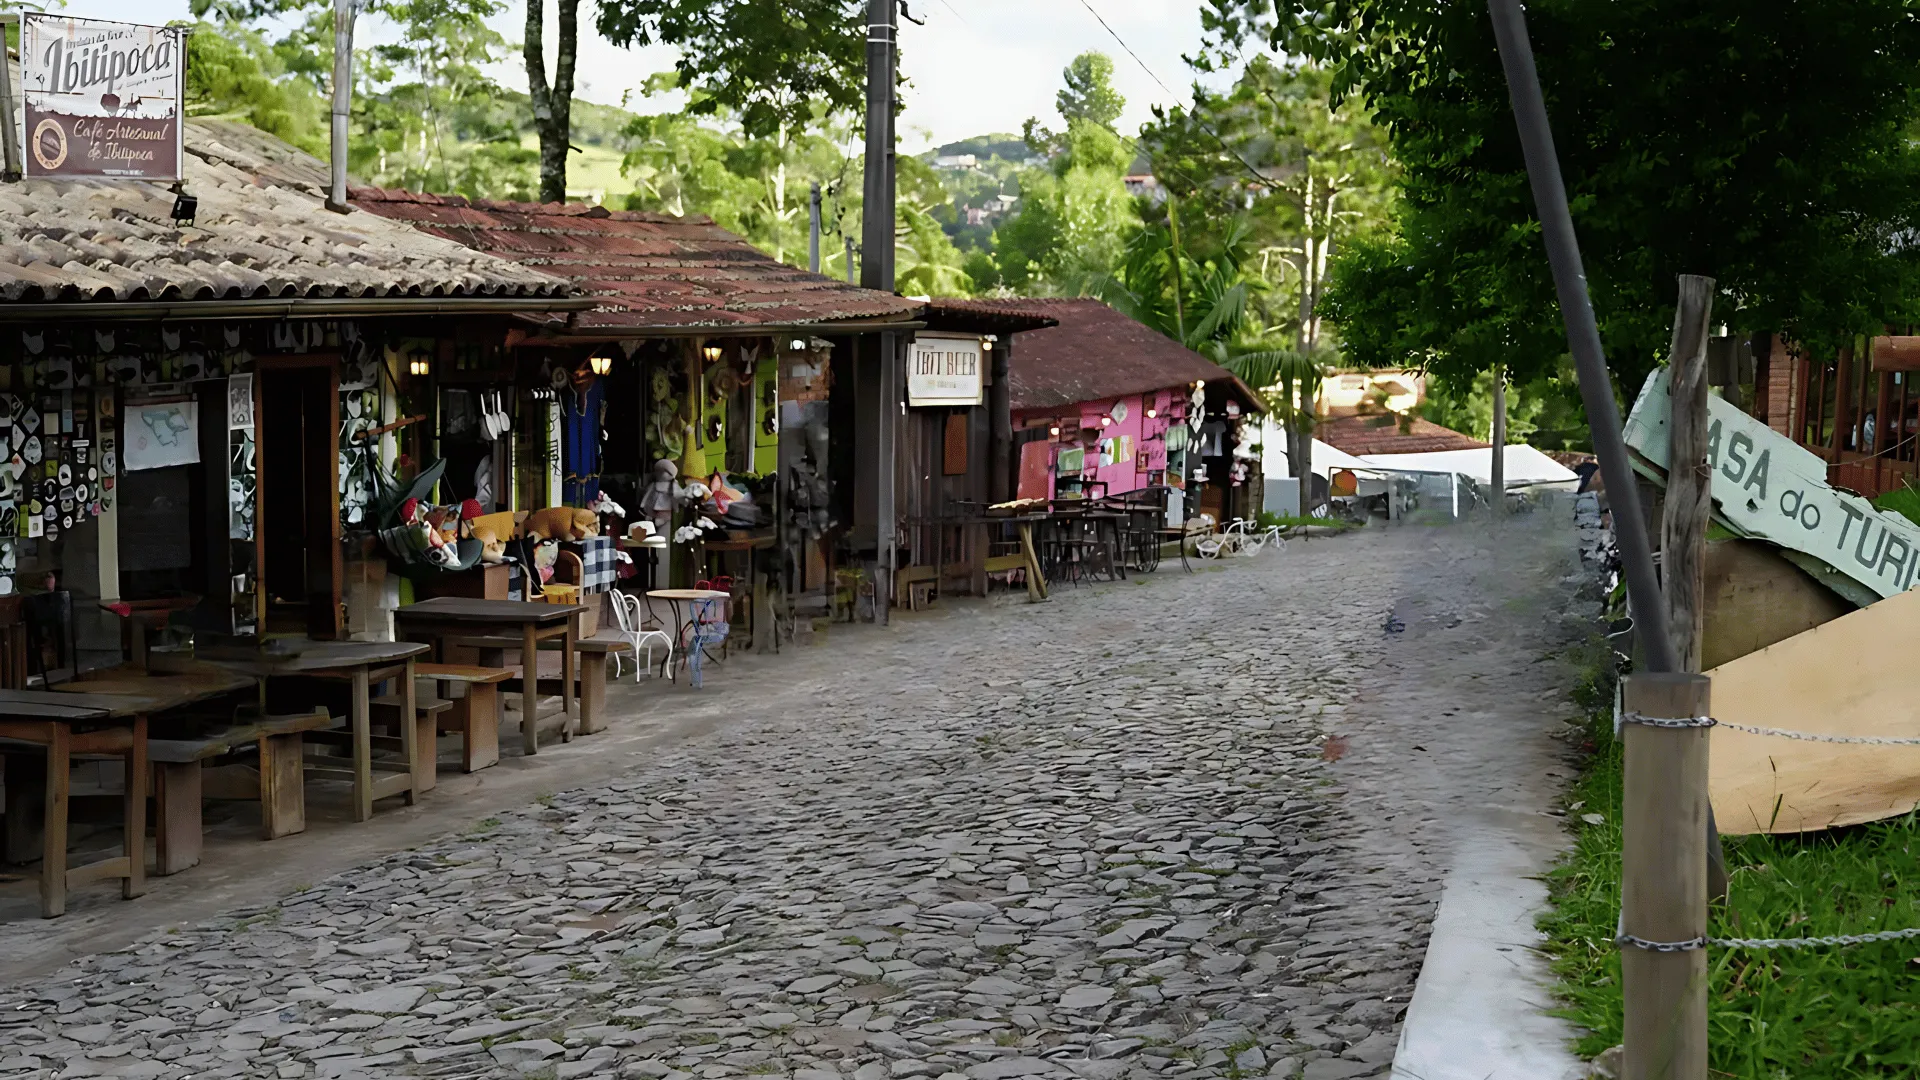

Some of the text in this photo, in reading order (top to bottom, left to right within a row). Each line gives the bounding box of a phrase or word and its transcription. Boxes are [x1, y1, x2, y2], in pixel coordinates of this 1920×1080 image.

[43, 36, 171, 95] Ibitipoca
[73, 118, 104, 145] Café
[106, 121, 169, 140] Artesanal
[103, 142, 154, 167] Ibitipoca
[947, 351, 976, 375] BEER
[1706, 408, 1920, 591] ASA do TURI
